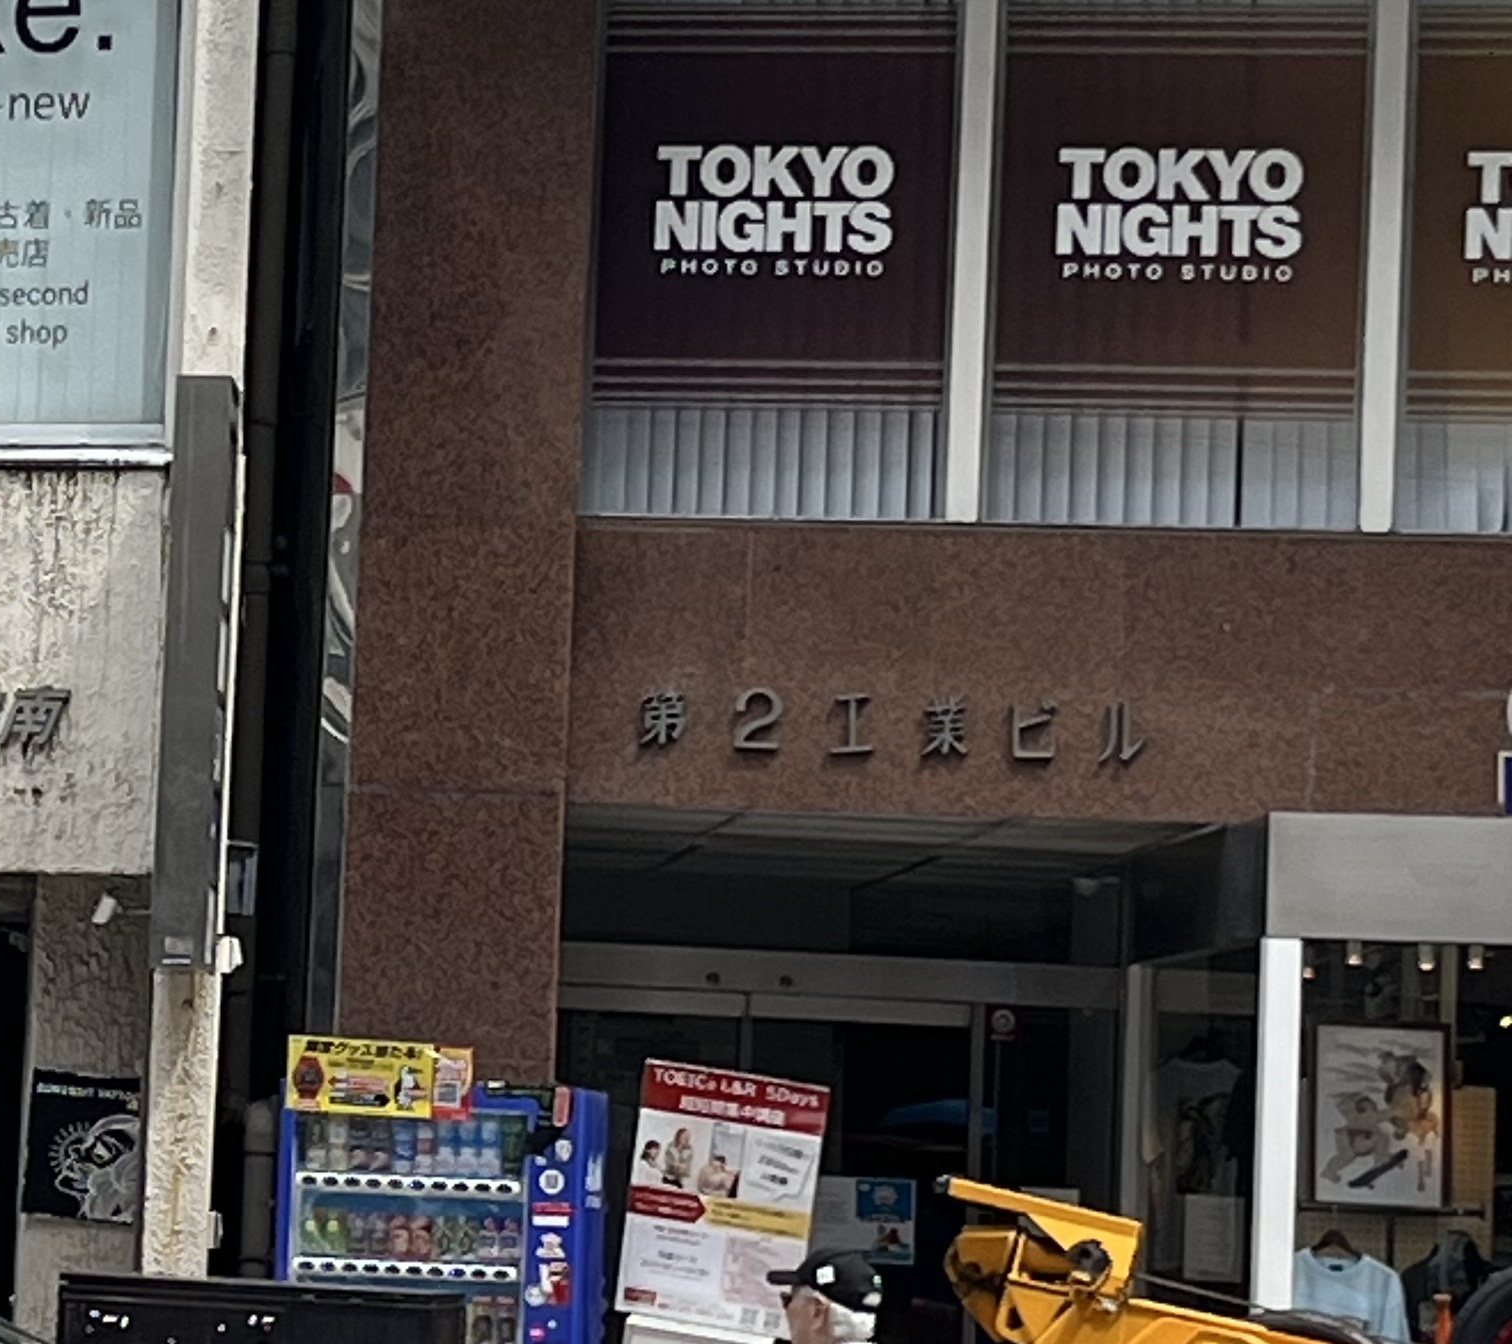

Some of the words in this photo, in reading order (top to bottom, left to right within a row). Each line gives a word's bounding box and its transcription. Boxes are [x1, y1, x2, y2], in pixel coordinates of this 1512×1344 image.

[657, 144, 895, 199] TOKYO
[1059, 147, 1304, 203] TOKYO
[653, 200, 894, 255] NIGHTS
[1055, 203, 1302, 259] NIGHTS
[660, 258, 759, 276] PHOTO
[774, 259, 885, 277] STUDIO
[1062, 262, 1164, 281] PHOTO
[1181, 263, 1293, 282] STUDIO
[6, 320, 68, 348] shop
[639, 686, 1146, 764] 第2工業ビル
